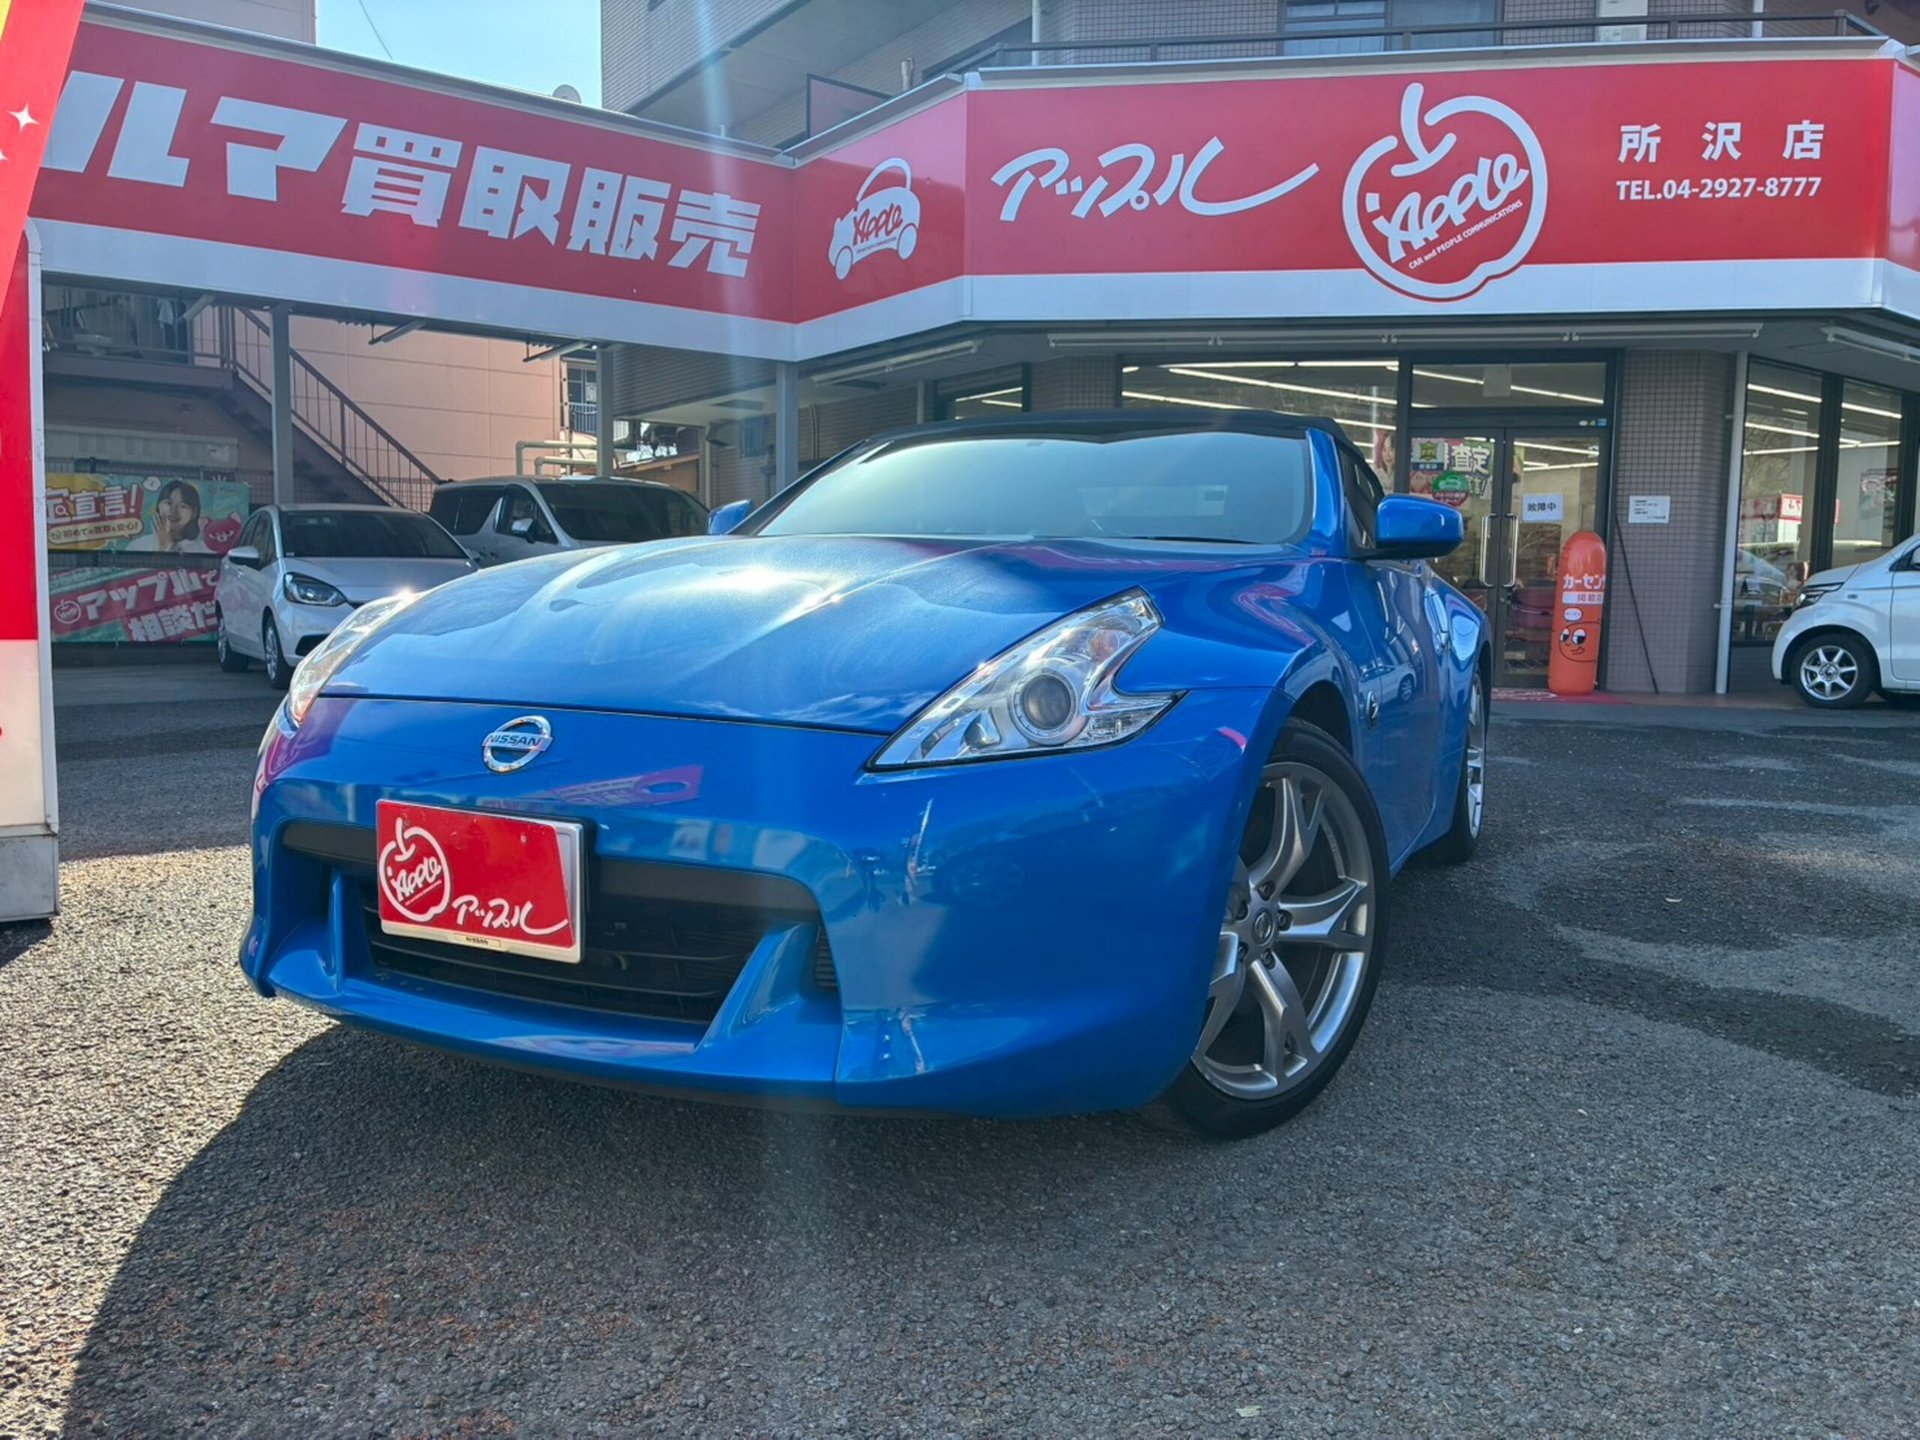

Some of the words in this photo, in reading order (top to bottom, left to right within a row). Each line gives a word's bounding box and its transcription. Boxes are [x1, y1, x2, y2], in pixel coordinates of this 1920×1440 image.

[1617, 119, 1825, 163] 所沢店
[991, 136, 1320, 221] アップル
[1616, 177, 1822, 200] TEL.04-2927-8777
[852, 201, 903, 247] Apple
[1366, 153, 1530, 263] Apple
[1408, 257, 1425, 270] CAR
[1424, 248, 1438, 262] and
[1436, 233, 1462, 254] PEOPLE
[1462, 199, 1523, 239] COMMUNICATIONS
[491, 734, 541, 747] NISSAN
[387, 856, 442, 902] Apple
[452, 894, 569, 936] アップル
